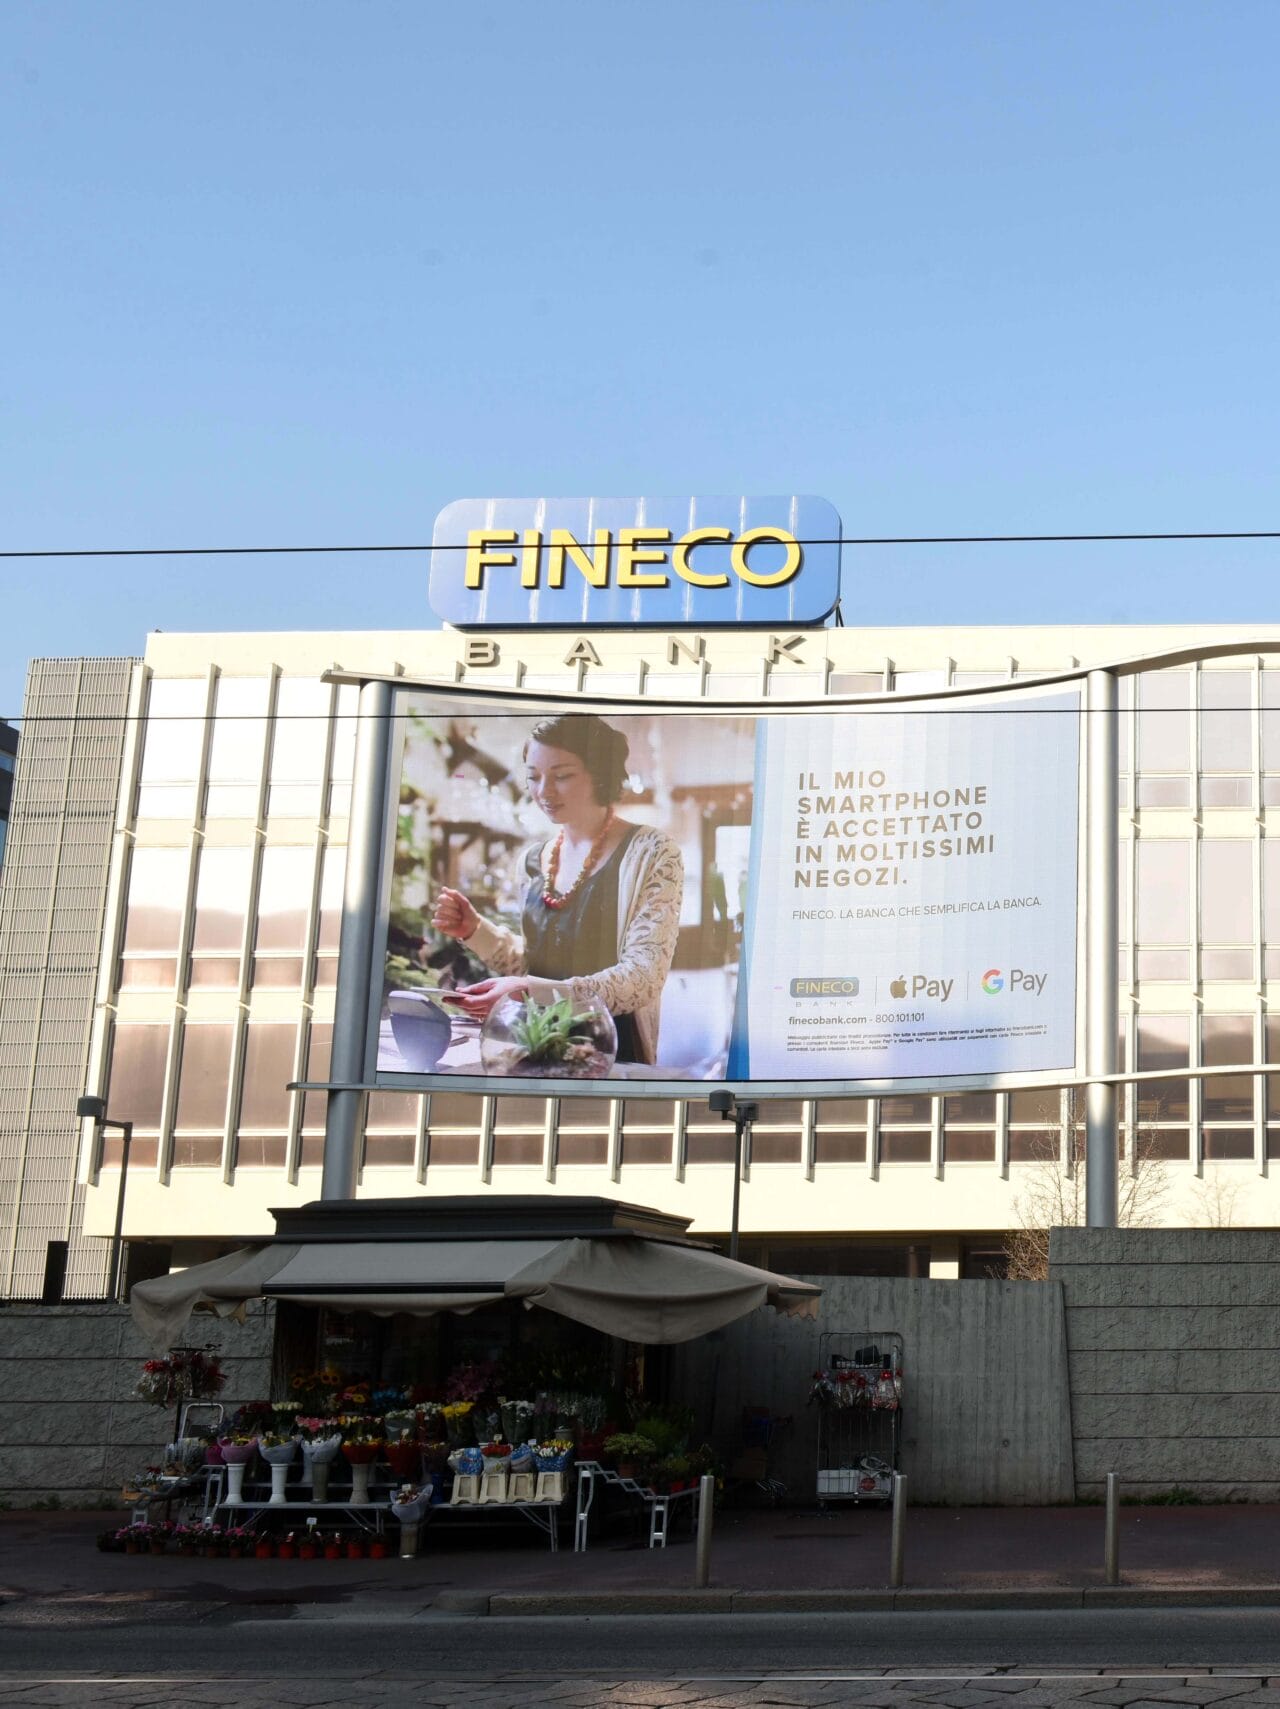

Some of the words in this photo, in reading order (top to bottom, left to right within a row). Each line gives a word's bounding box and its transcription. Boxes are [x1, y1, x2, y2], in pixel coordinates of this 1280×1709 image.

[464, 526, 801, 588] FINECO
[464, 635, 806, 666] BANK
[799, 772, 820, 790] IL
[834, 770, 886, 790] MIO
[797, 786, 988, 815] SMARTPHONE
[796, 817, 810, 839] È
[823, 811, 983, 839] ACCETTATO
[795, 845, 823, 864] IN
[835, 834, 994, 863] MOLTISSIMI
[794, 867, 908, 888] NEGOZI.
[792, 909, 836, 920] FINECO.
[839, 909, 854, 919] LA
[856, 908, 896, 919] BANCA
[897, 906, 921, 917] CHE
[923, 901, 985, 915] SEMPLIFICA
[987, 899, 1001, 911] LA
[1003, 896, 1042, 910] BANCA.
[796, 980, 854, 994] FINECO
[912, 975, 954, 1002] Pay
[1010, 969, 1048, 996] Pay
[788, 1015, 867, 1025] finecobank.com
